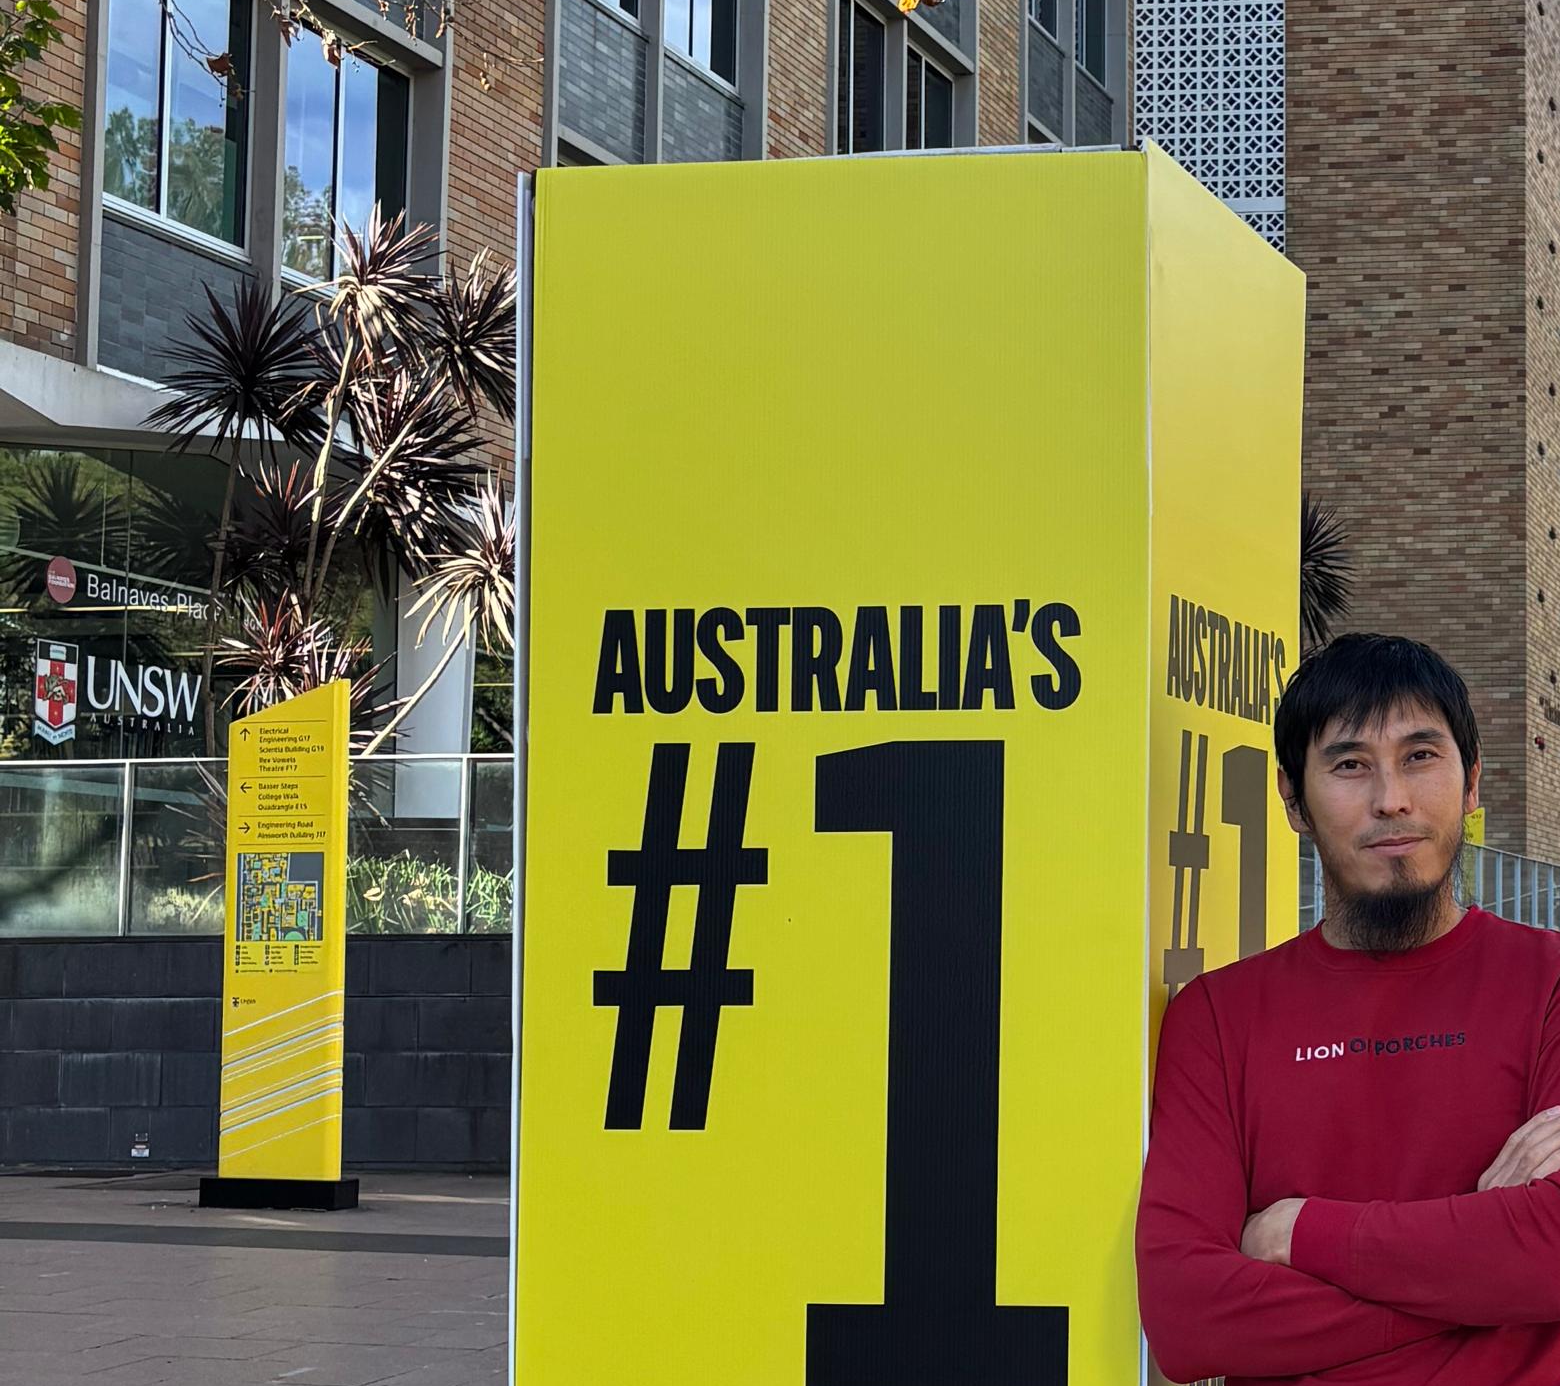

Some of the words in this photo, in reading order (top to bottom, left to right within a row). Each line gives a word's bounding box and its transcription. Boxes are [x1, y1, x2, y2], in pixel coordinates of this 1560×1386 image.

[87, 574, 169, 612] Balnaves
[592, 598, 1082, 715] AUSTRALIA'S
[87, 655, 203, 722] UNSW
[89, 713, 195, 736] AUSTRALIA
[1295, 1042, 1345, 1061] LION
[1374, 1032, 1466, 1056] PORCHES
